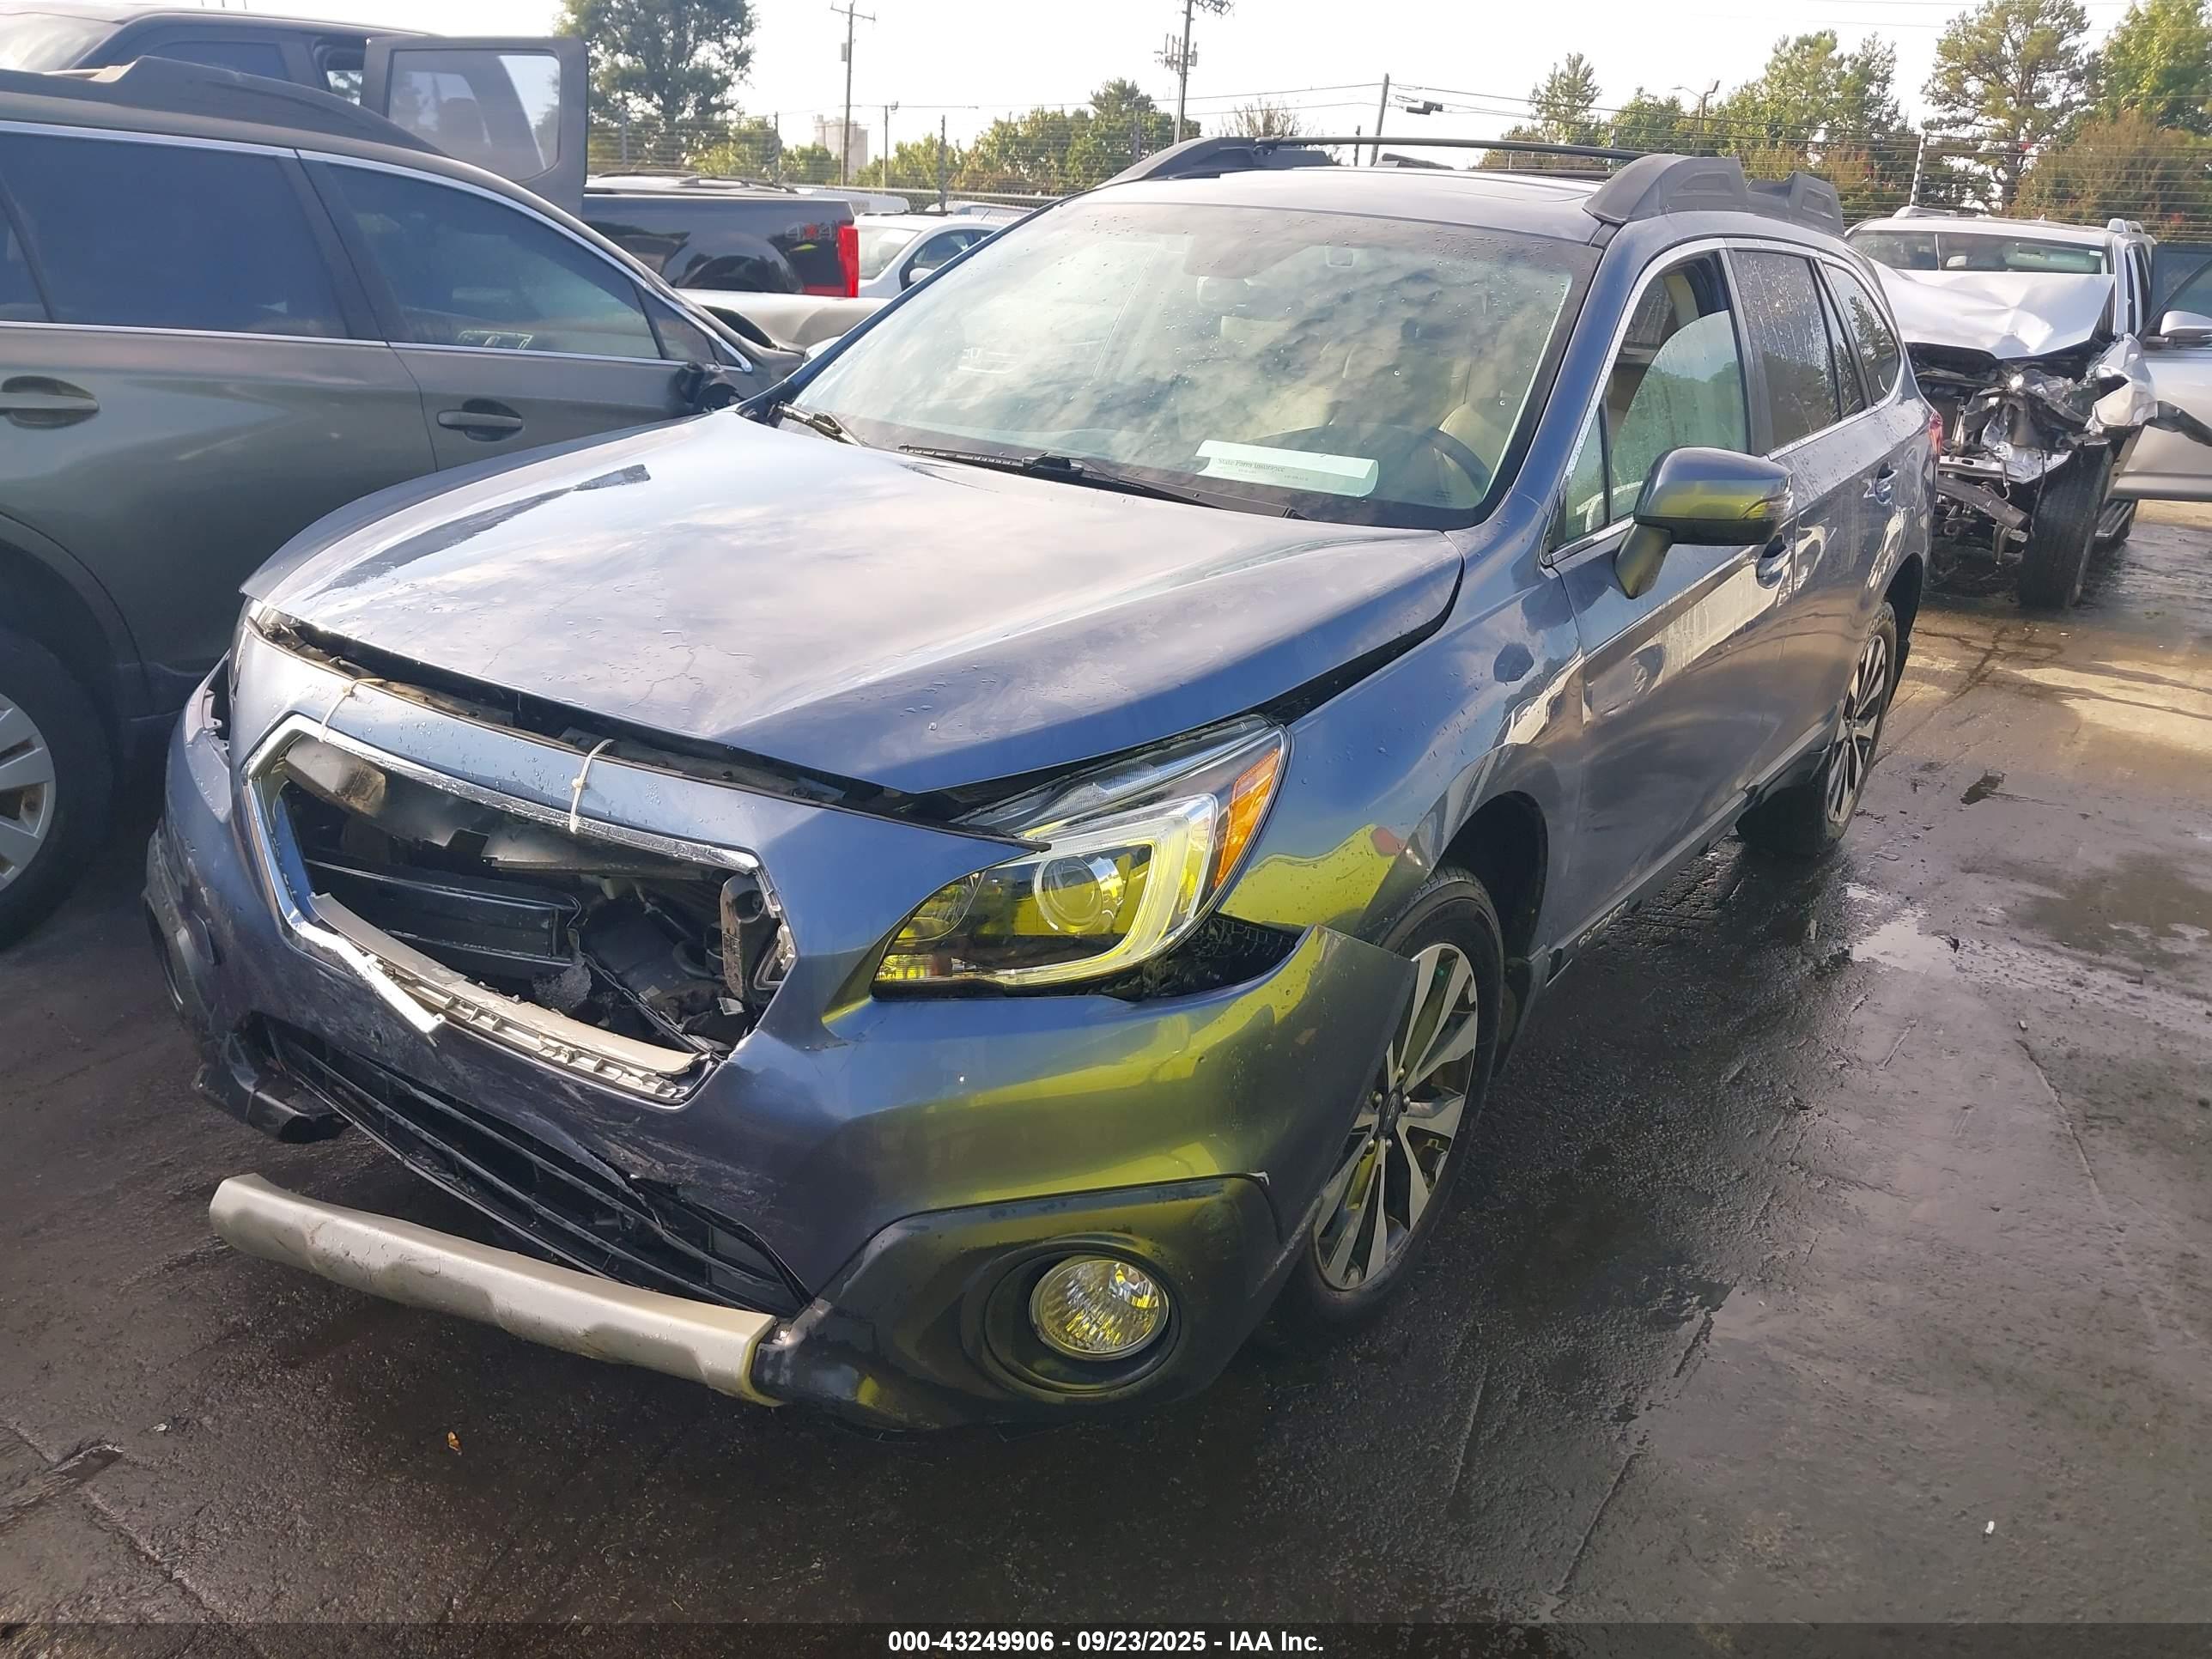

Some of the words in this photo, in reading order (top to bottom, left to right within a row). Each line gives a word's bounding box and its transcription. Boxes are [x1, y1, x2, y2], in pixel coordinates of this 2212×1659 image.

[1218, 458, 1235, 467] State
[1235, 459, 1253, 469] Farm
[1254, 462, 1286, 473] Insurance
